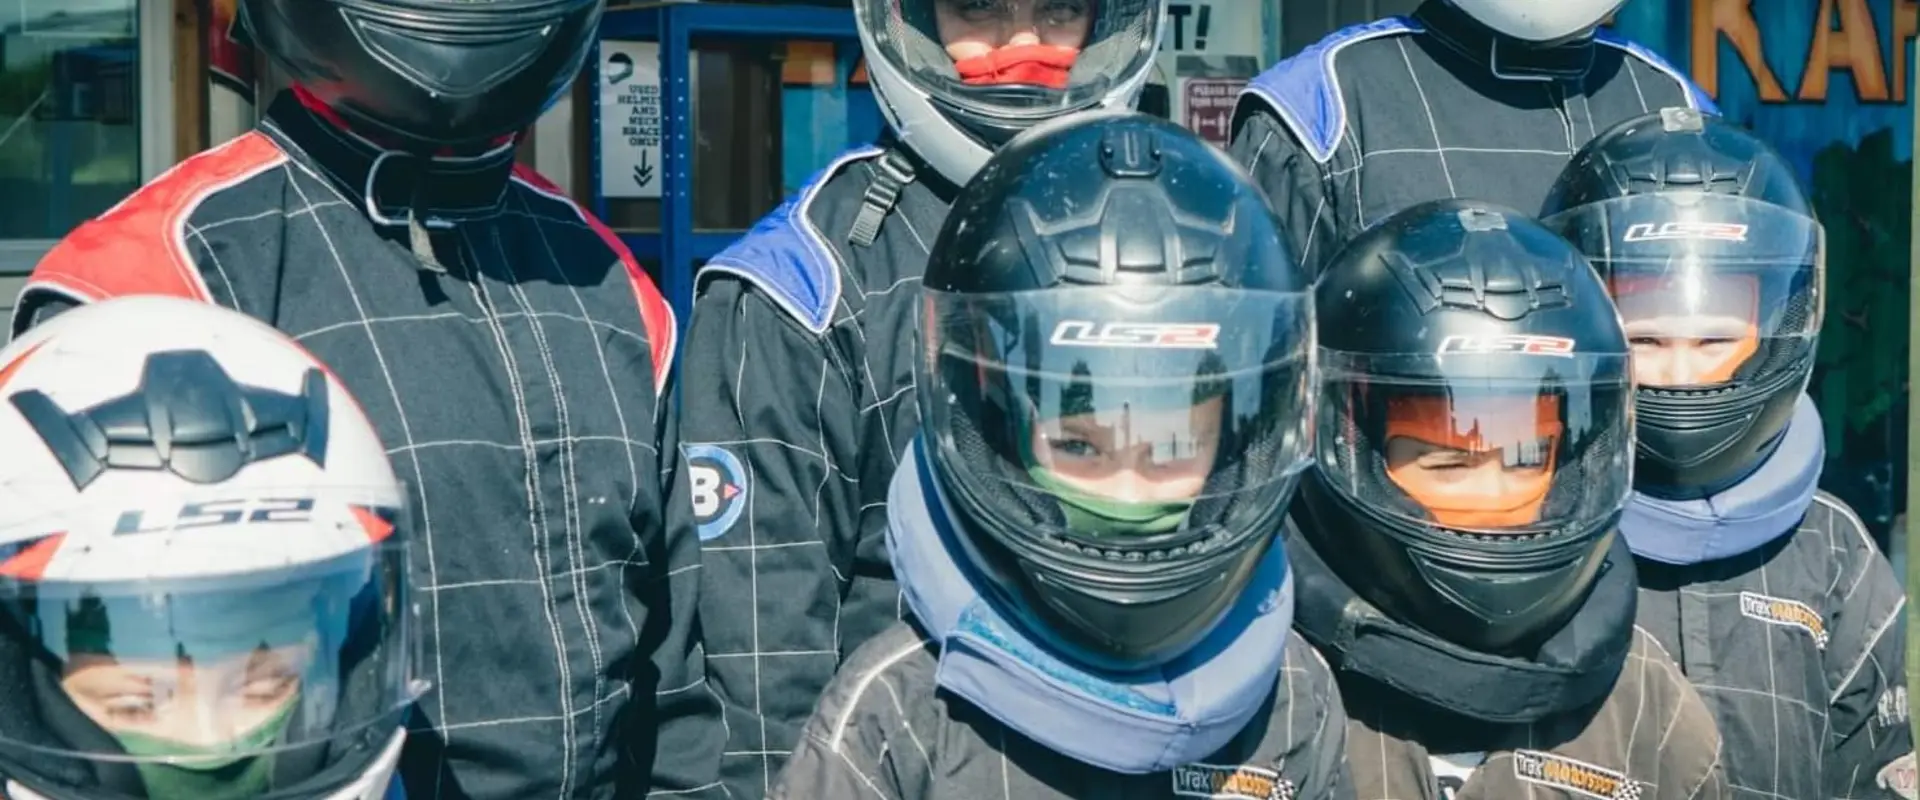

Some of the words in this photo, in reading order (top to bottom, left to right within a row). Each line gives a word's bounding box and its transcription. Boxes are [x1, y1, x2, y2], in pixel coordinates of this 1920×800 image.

[1159, 4, 1212, 51] T!
[631, 106, 658, 116] AND
[629, 137, 659, 147] ONLY
[1623, 222, 1749, 243] LS2
[1050, 319, 1221, 350] LS2
[1436, 335, 1576, 359] LS2
[111, 498, 316, 537] LS2
[1177, 767, 1210, 791] Trax
